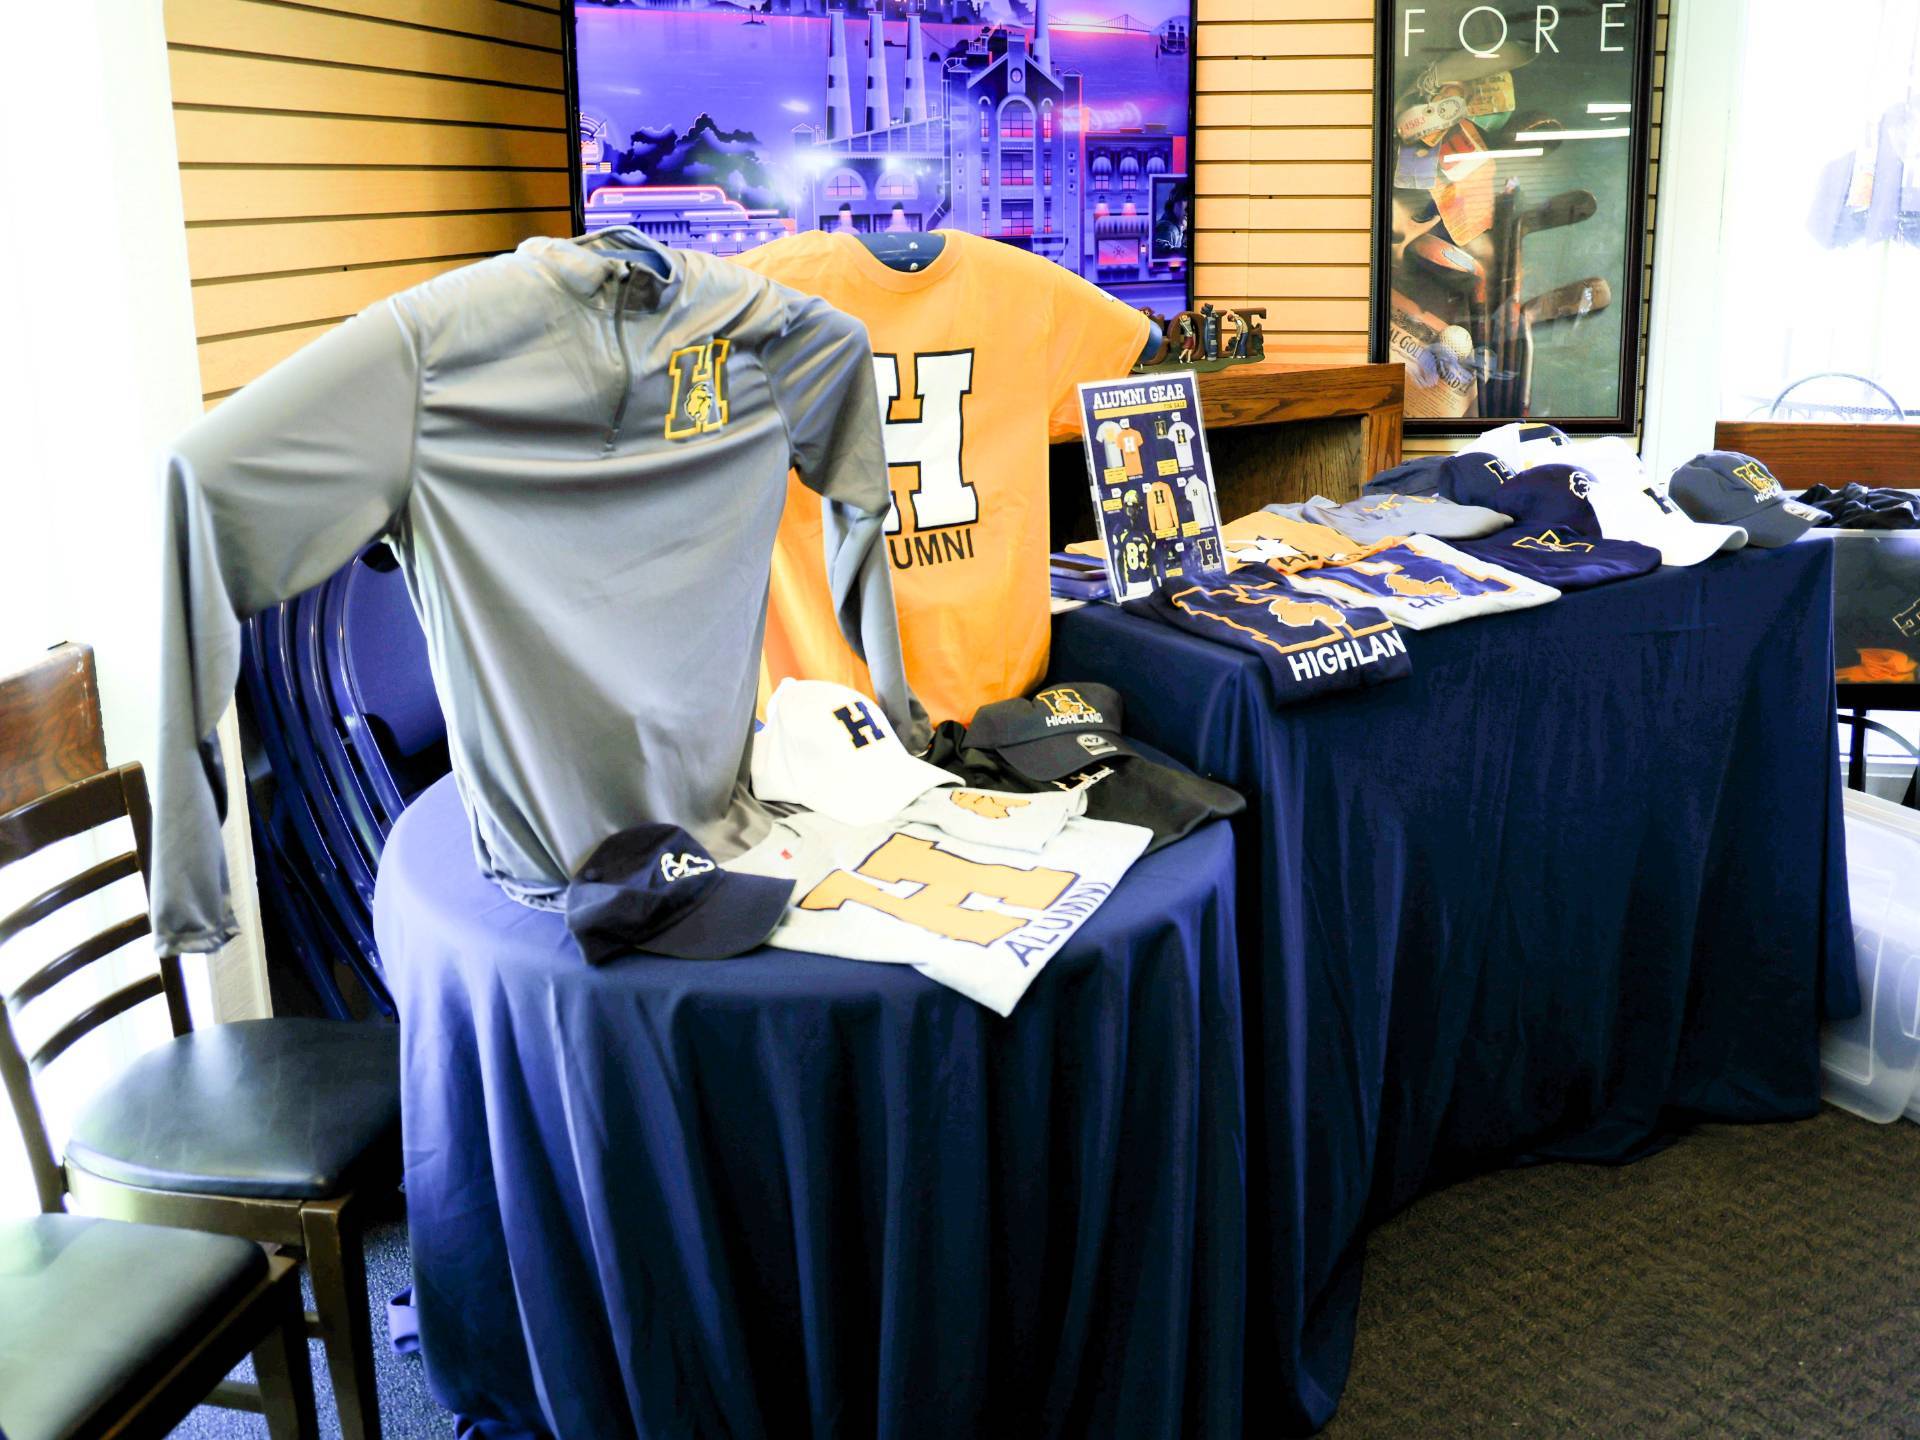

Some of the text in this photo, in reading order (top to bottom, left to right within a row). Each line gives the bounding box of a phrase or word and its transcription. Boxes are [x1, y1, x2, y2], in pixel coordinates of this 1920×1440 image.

[1404, 3, 1627, 57] FORE
[664, 338, 731, 441] H
[1093, 383, 1186, 410] ALUMNI GEAR
[873, 347, 979, 536] H
[1125, 542, 1148, 570] 83
[1287, 629, 1407, 682] HIGHLAN
[832, 701, 886, 749] H
[1045, 712, 1104, 728] HIGHLAND
[799, 832, 1081, 948] H
[1005, 881, 1112, 968] ALUMNI
